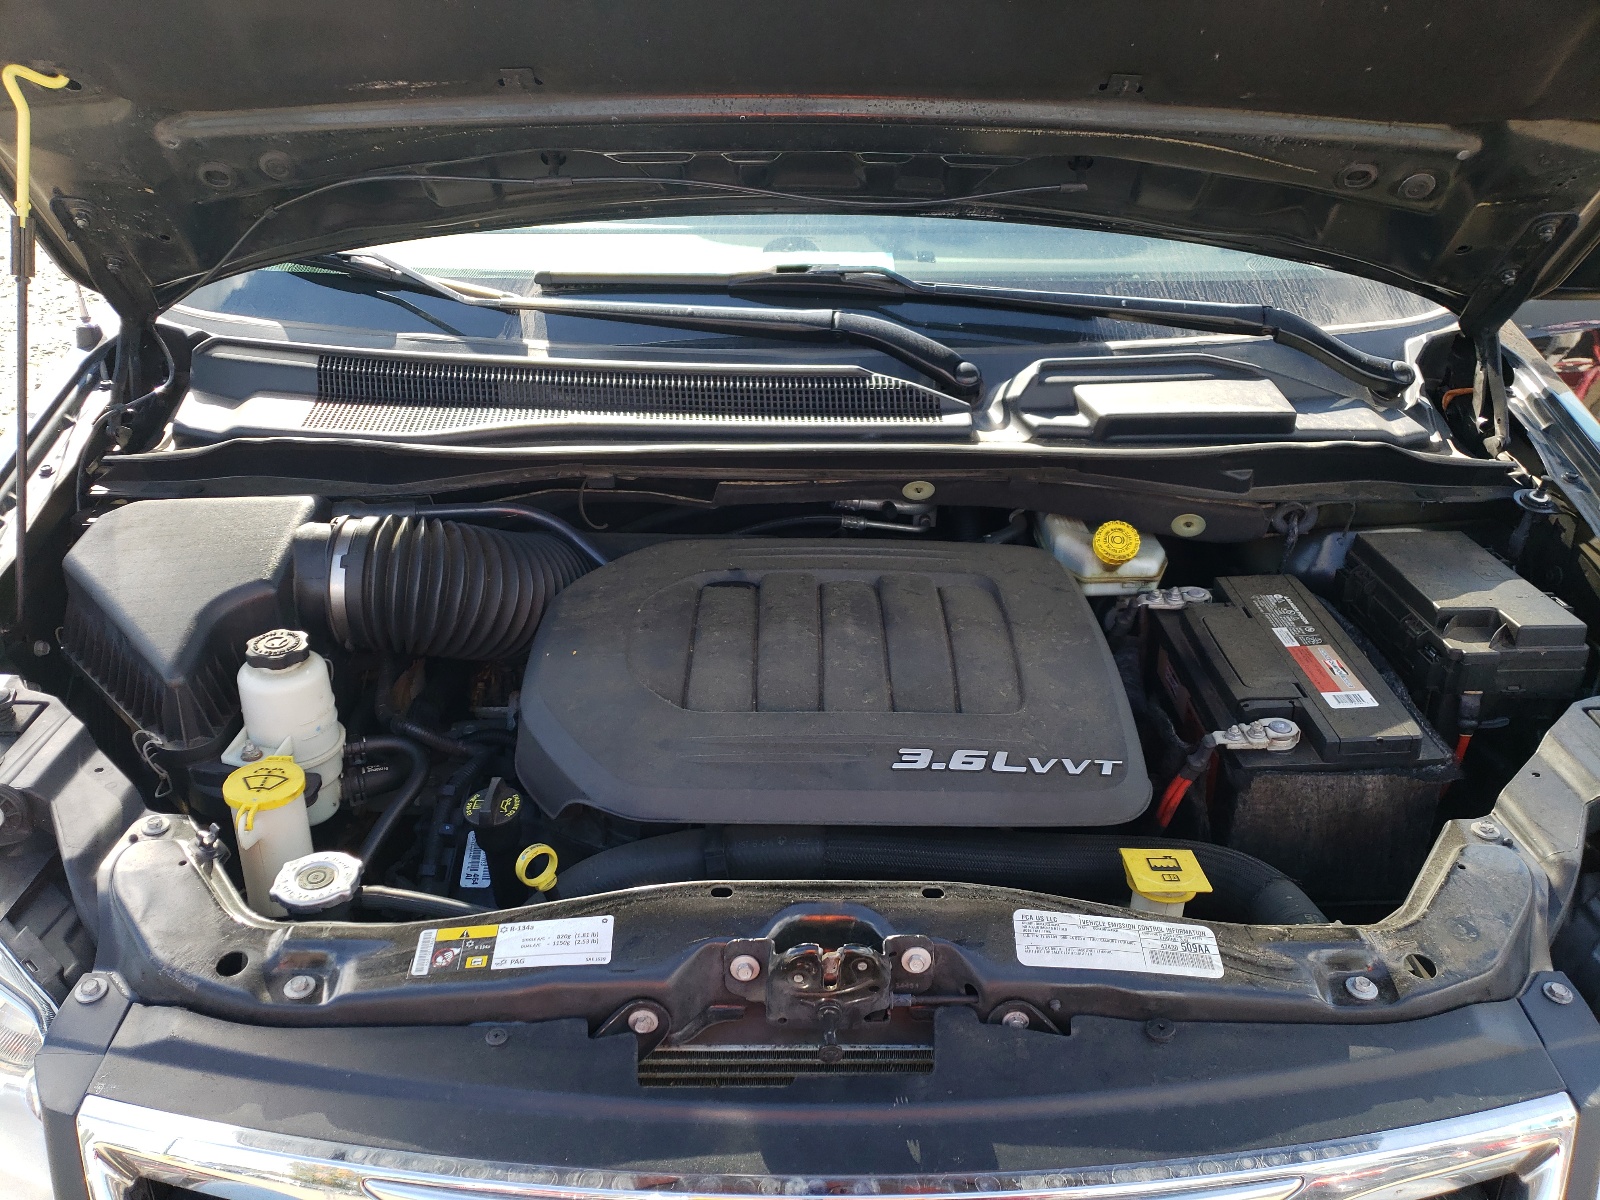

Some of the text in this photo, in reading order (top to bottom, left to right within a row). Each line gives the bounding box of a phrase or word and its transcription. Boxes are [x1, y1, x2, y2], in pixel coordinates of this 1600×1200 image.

[890, 747, 1123, 776] 3.6L VVT
[1081, 919, 1106, 927] VEHICLE
[1107, 921, 1136, 930] EMISSION
[1137, 924, 1164, 933] CONTROL
[1165, 927, 1206, 937] INFORMATION
[1180, 942, 1211, 954] 509AA
